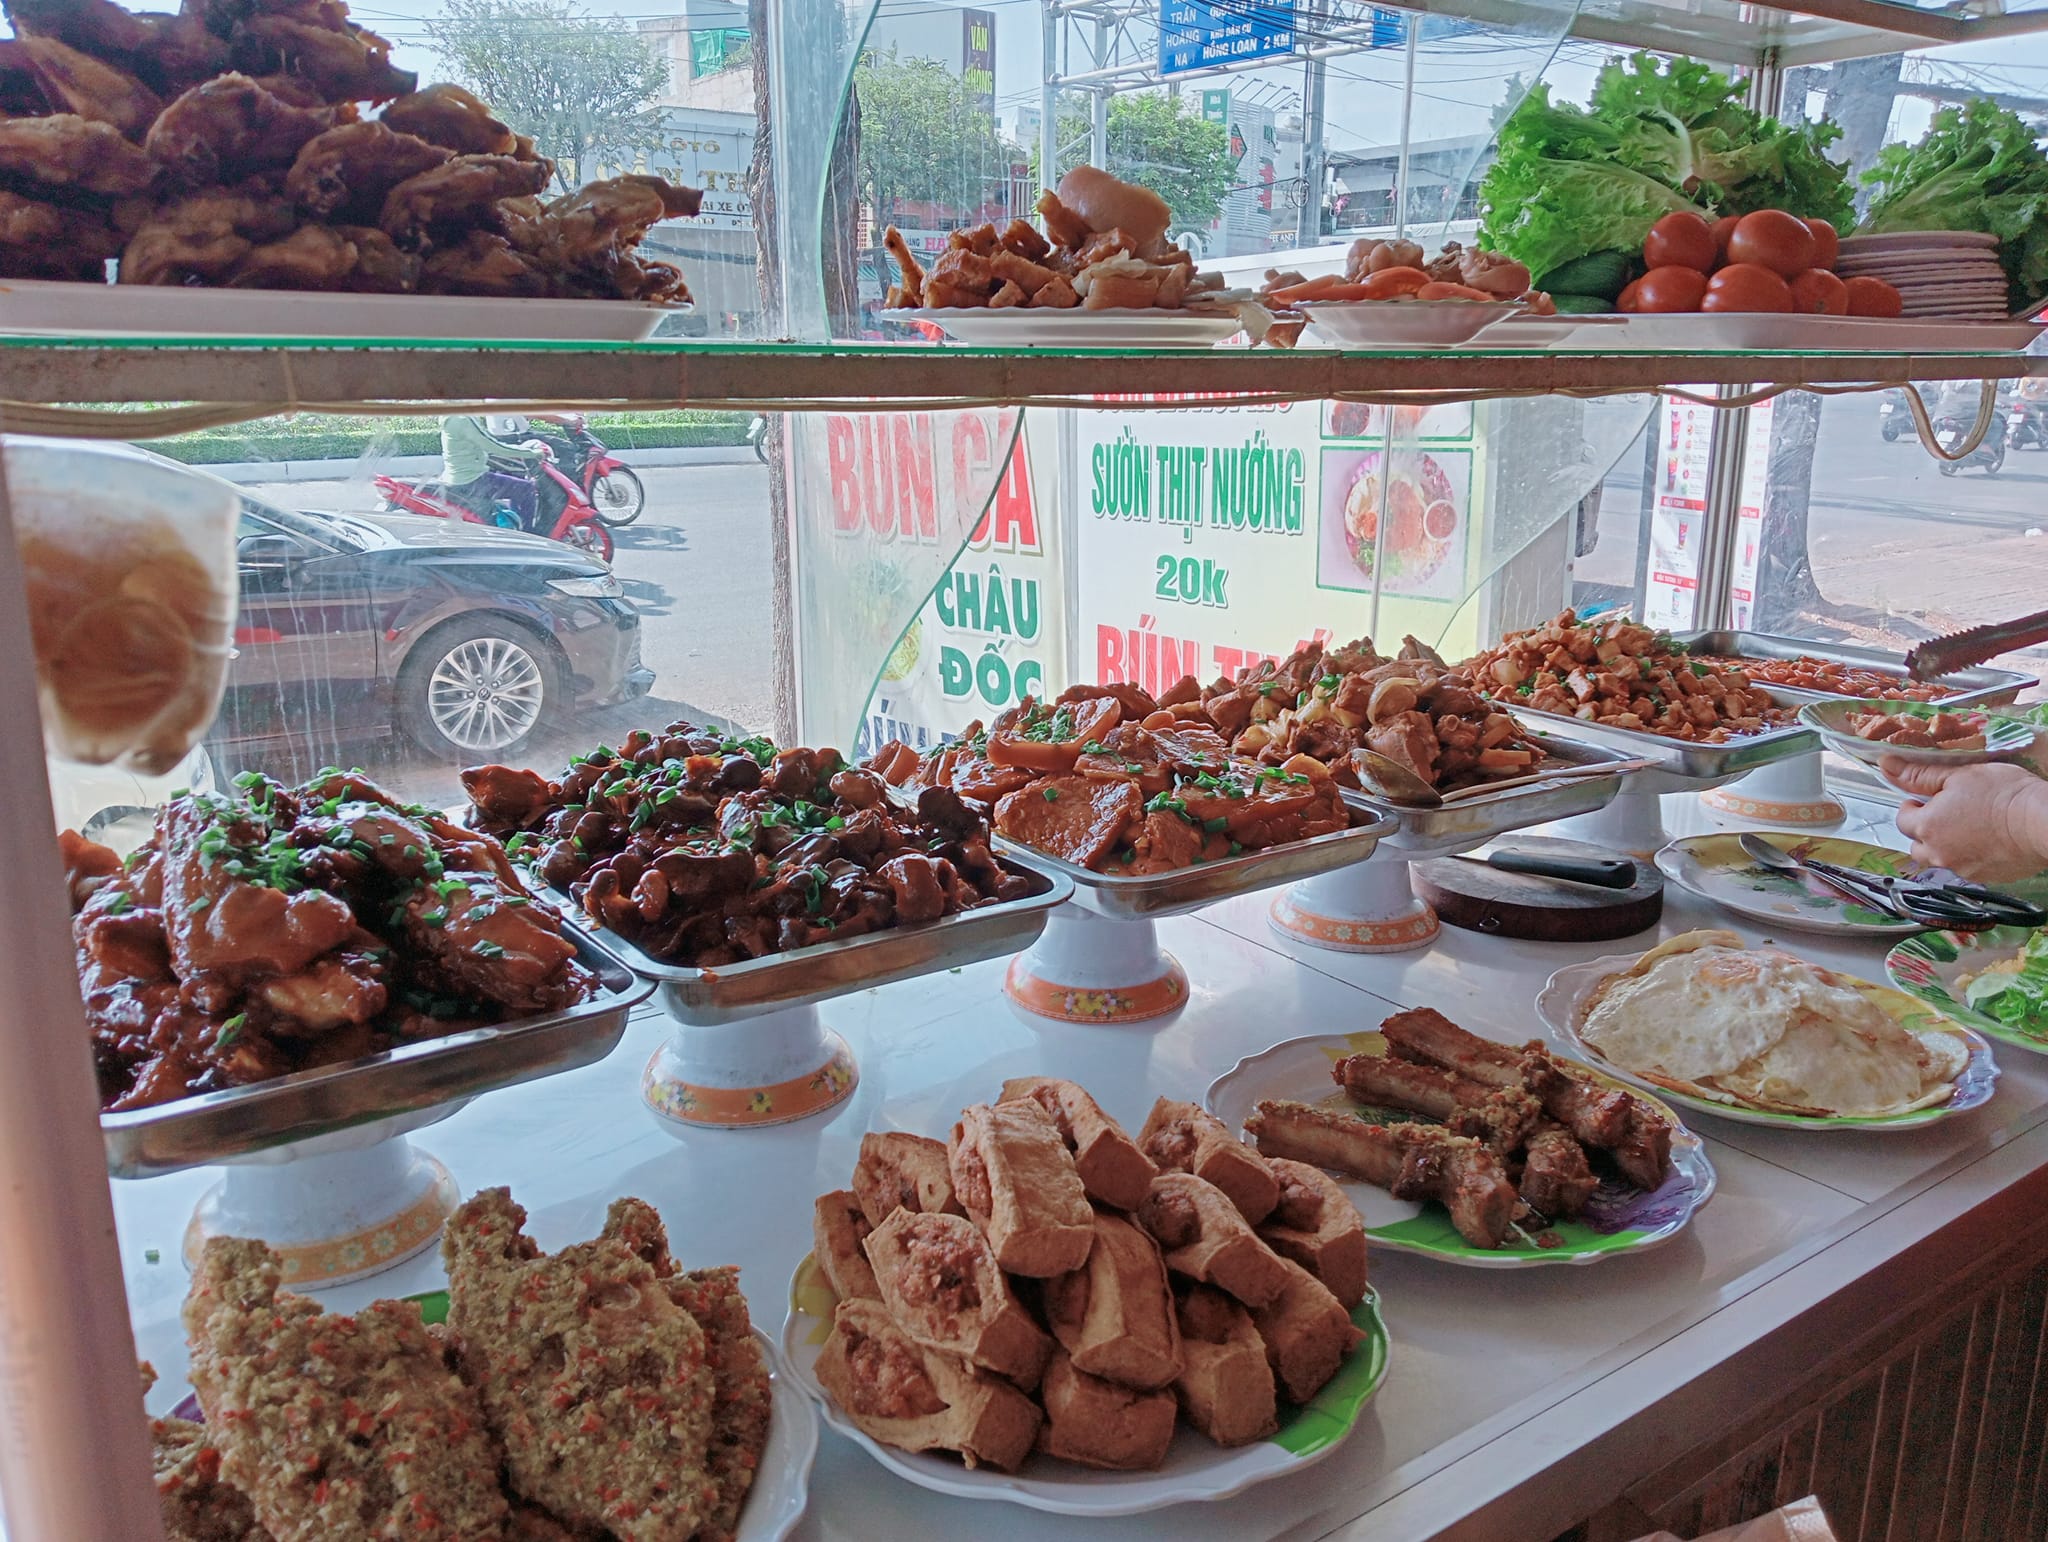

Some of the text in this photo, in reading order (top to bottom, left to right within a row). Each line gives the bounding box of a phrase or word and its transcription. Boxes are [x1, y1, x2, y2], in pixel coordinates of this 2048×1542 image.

[1170, 7, 1197, 26] TRẦN
[970, 20, 988, 52] VĂN
[1166, 29, 1200, 48] HOÀNG
[1231, 38, 1258, 55] LOAN
[1263, 36, 1270, 49] 2
[1273, 33, 1290, 48] KM
[1174, 53, 1188, 67] NA
[1090, 426, 1304, 543] SƯỜN THỊT NƯỚNG
[1155, 554, 1228, 608] 20k
[935, 563, 1039, 640] CHÂU
[938, 641, 1042, 706] ĐỐC
